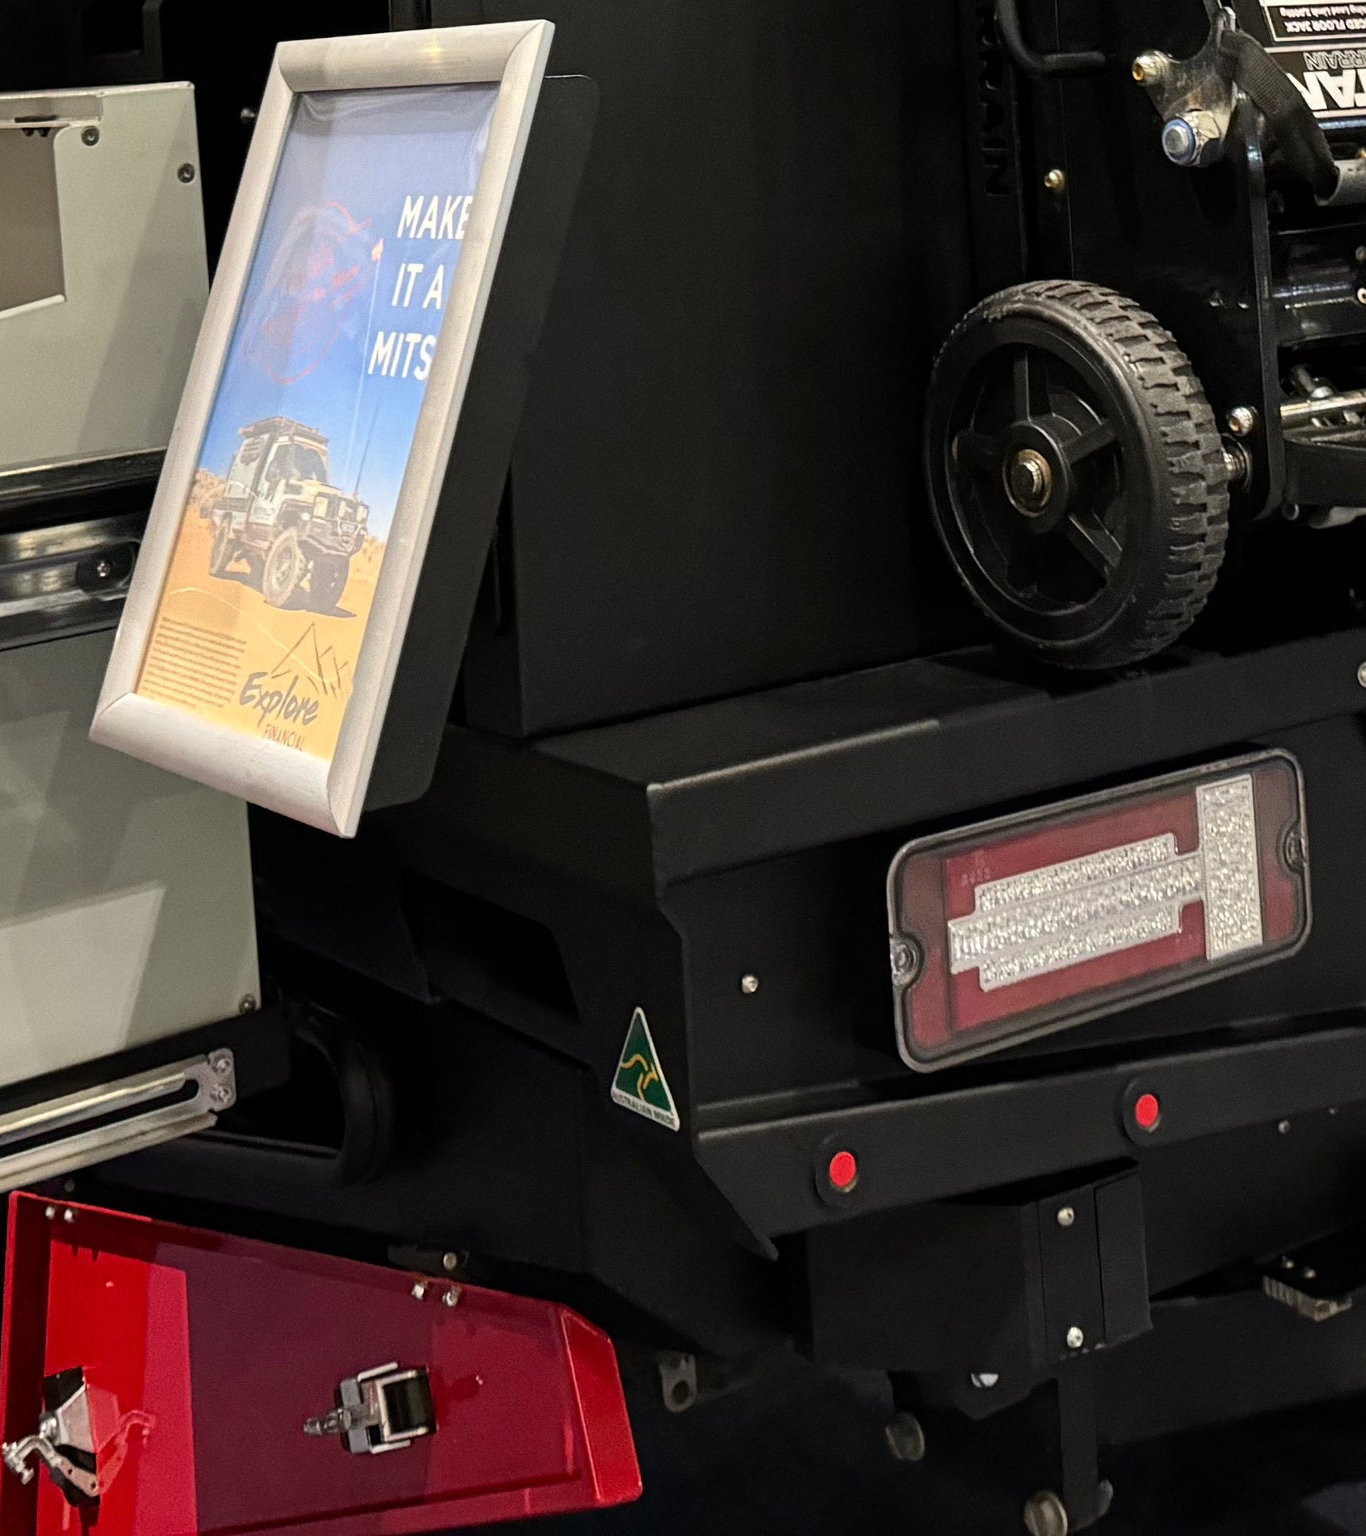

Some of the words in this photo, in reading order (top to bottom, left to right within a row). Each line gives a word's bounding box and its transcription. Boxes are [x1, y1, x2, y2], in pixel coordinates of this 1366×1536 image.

[1283, 19, 1312, 34] JACK
[1311, 17, 1346, 32] FLOOR
[396, 194, 474, 241] MAKE
[391, 262, 424, 308] IT
[421, 263, 445, 310] A
[367, 330, 438, 381] MITS
[238, 670, 320, 728] Explore
